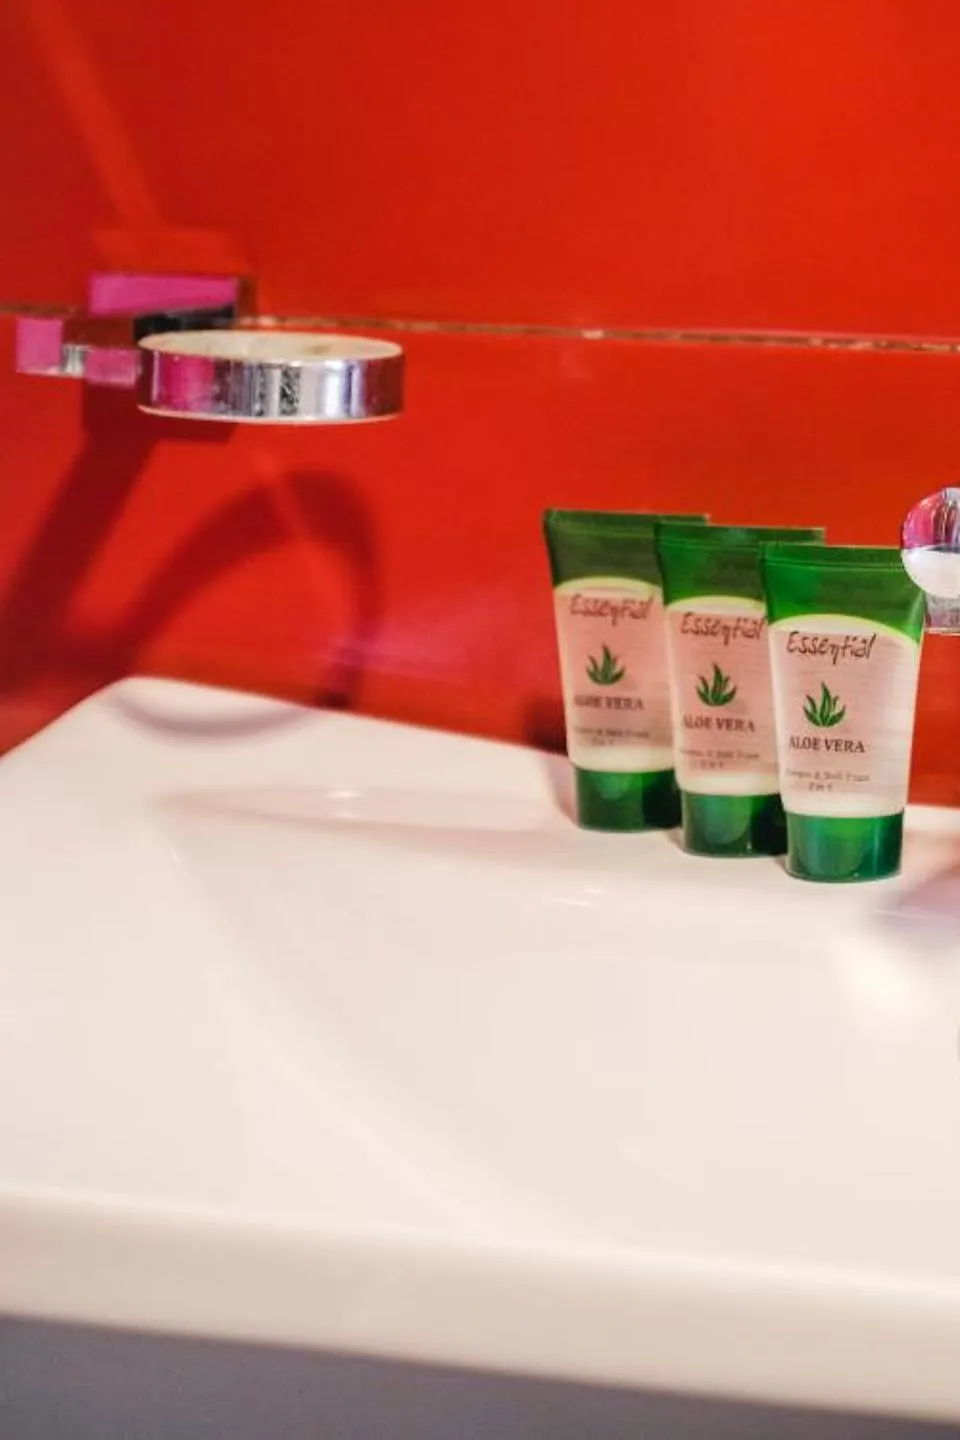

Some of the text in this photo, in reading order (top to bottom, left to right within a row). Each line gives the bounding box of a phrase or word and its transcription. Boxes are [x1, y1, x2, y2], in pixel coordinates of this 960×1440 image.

[786, 631, 877, 664] Essential
[605, 696, 645, 711] VERA
[682, 715, 755, 732] ALOE VERA
[789, 736, 865, 753] ALOE VERA
